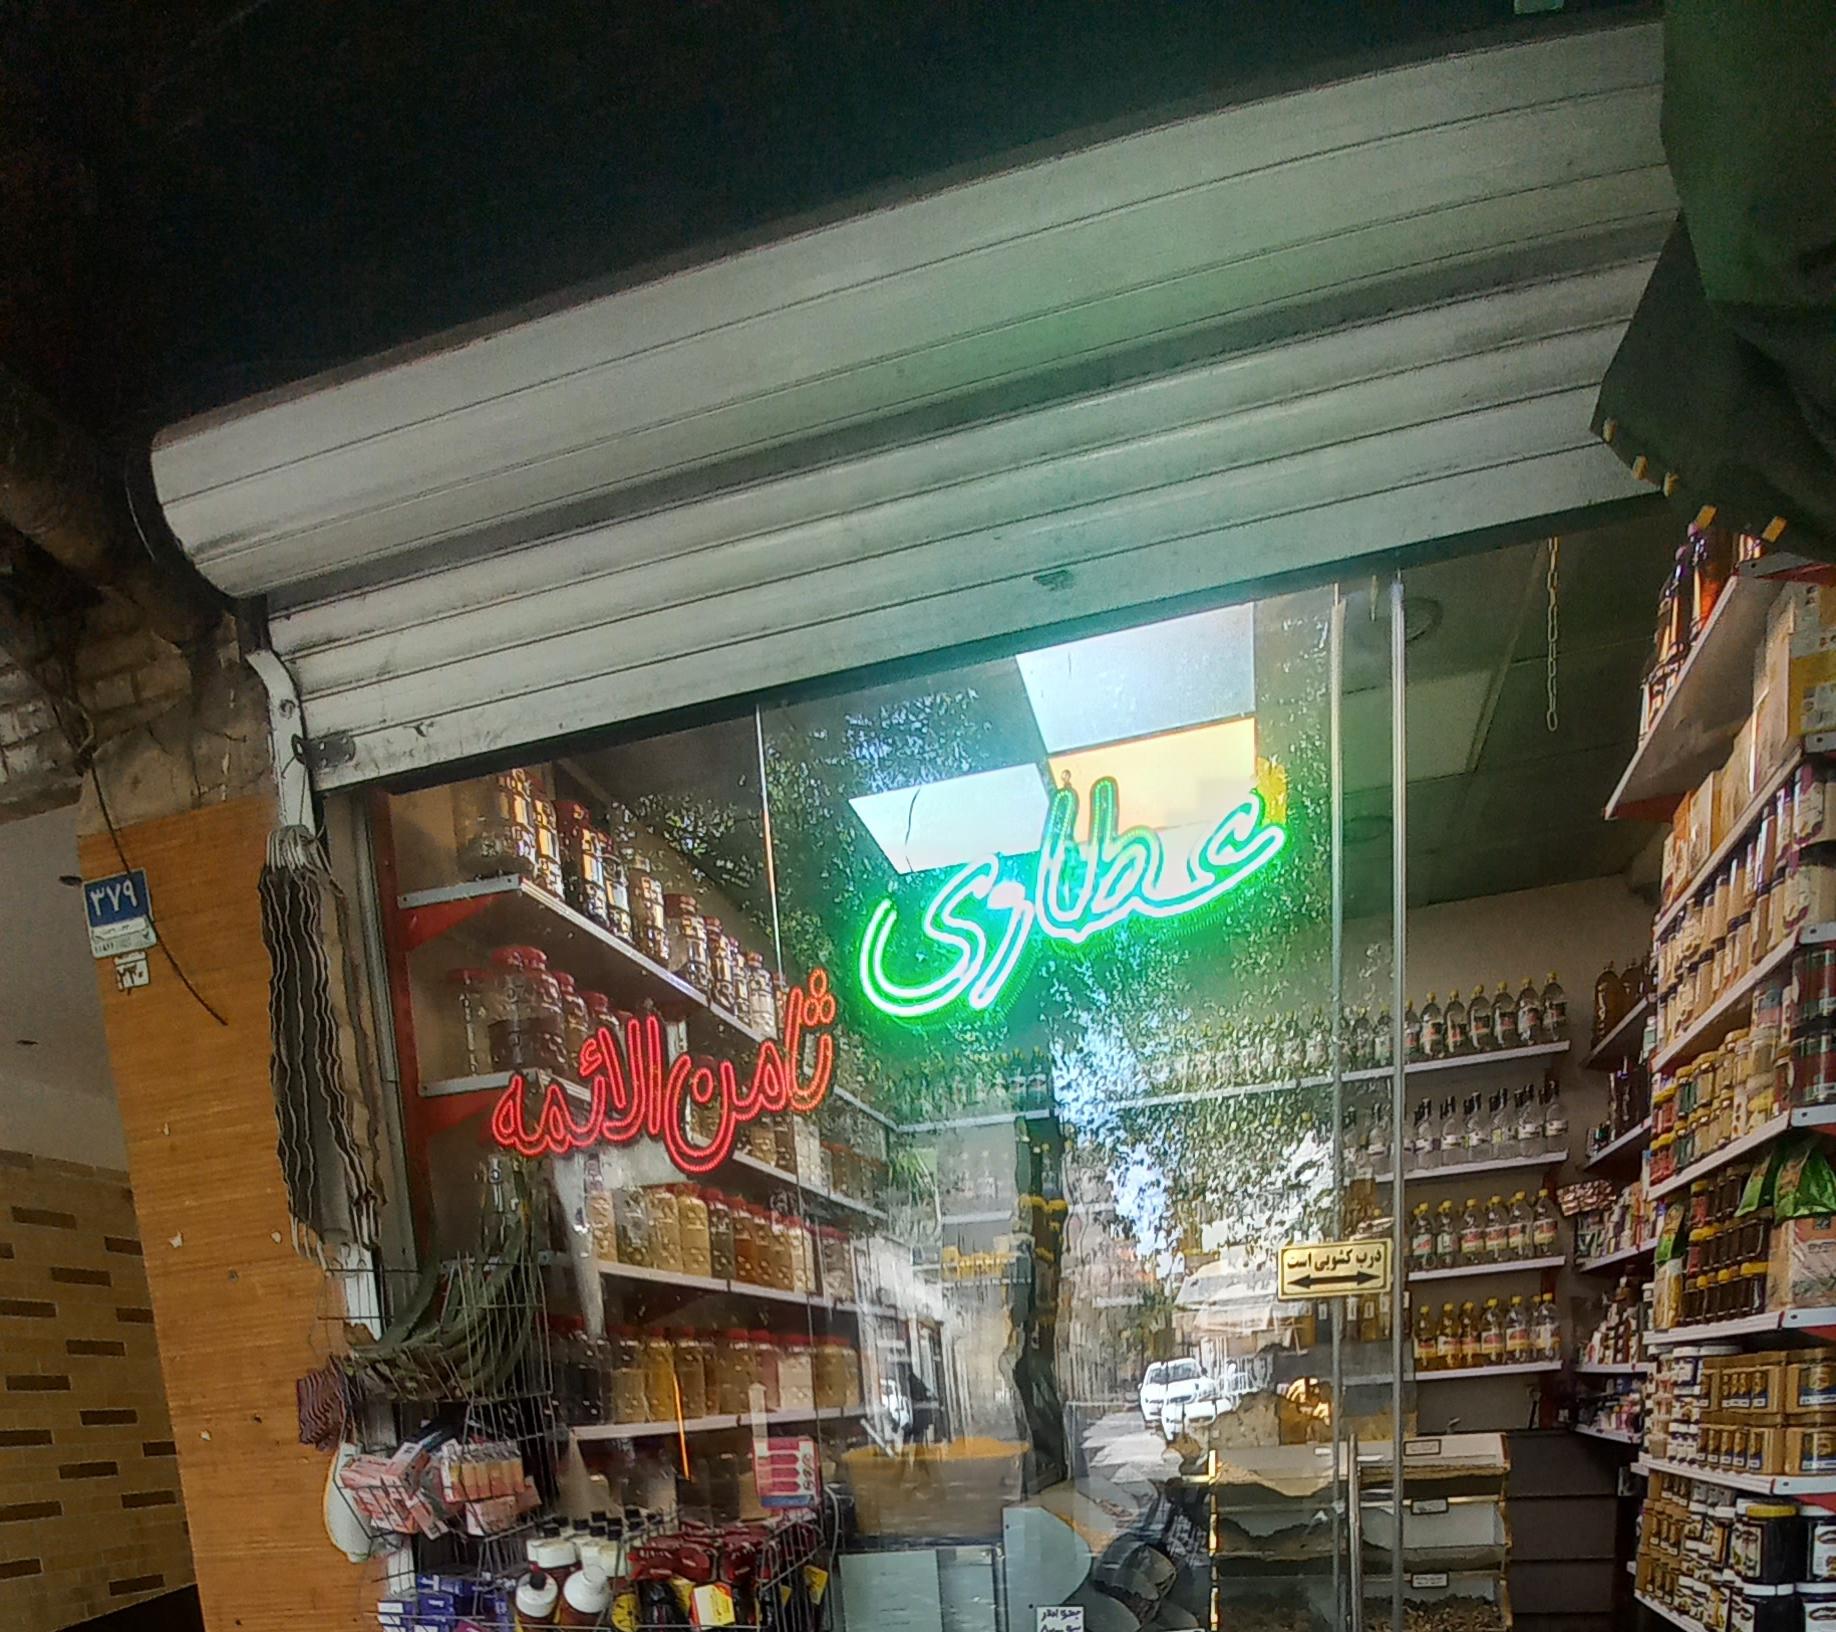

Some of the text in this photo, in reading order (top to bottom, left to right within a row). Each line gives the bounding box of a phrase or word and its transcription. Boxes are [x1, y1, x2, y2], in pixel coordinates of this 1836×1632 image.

[89, 879, 137, 916] ۳۷۹
[859, 777, 1287, 1018] عطاری
[662, 968, 836, 1173] ثامن
[1287, 1249, 1382, 1272] درب کشویی است
